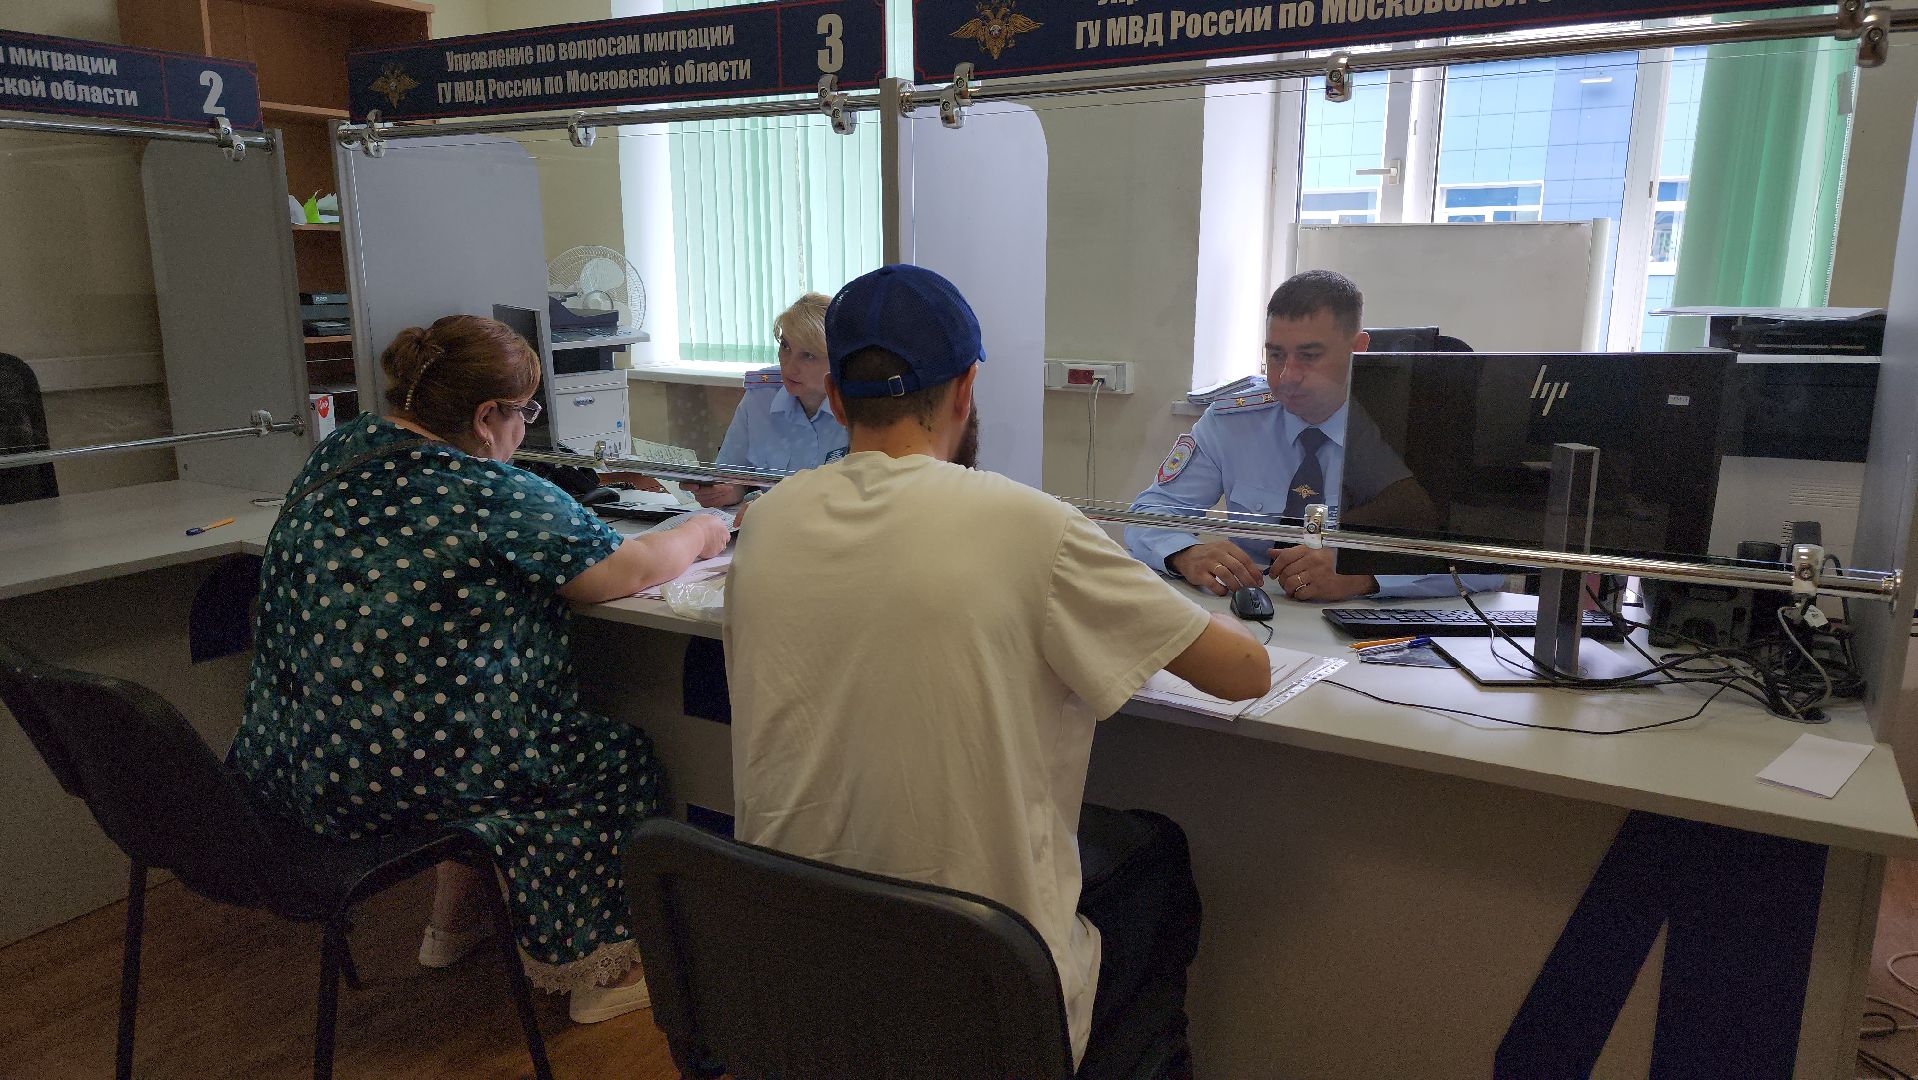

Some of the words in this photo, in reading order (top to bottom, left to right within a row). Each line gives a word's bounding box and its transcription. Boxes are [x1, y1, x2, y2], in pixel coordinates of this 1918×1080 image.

[445, 45, 534, 72] Управление
[536, 43, 556, 63] по
[558, 34, 641, 61] вопросам
[643, 24, 735, 52] миграции
[817, 13, 844, 73] 3
[1076, 20, 1101, 49] ГУ
[1106, 13, 1164, 47] МВД
[1170, 5, 1272, 40] России
[1278, 1, 1315, 29] по
[9, 46, 118, 76] миграции
[437, 82, 452, 103] ГУ
[454, 79, 486, 104] МВД
[488, 77, 542, 99] России
[544, 75, 563, 94] по
[566, 60, 671, 93] Московской
[674, 58, 751, 86] области
[49, 79, 139, 107] области
[199, 70, 226, 115] 2
